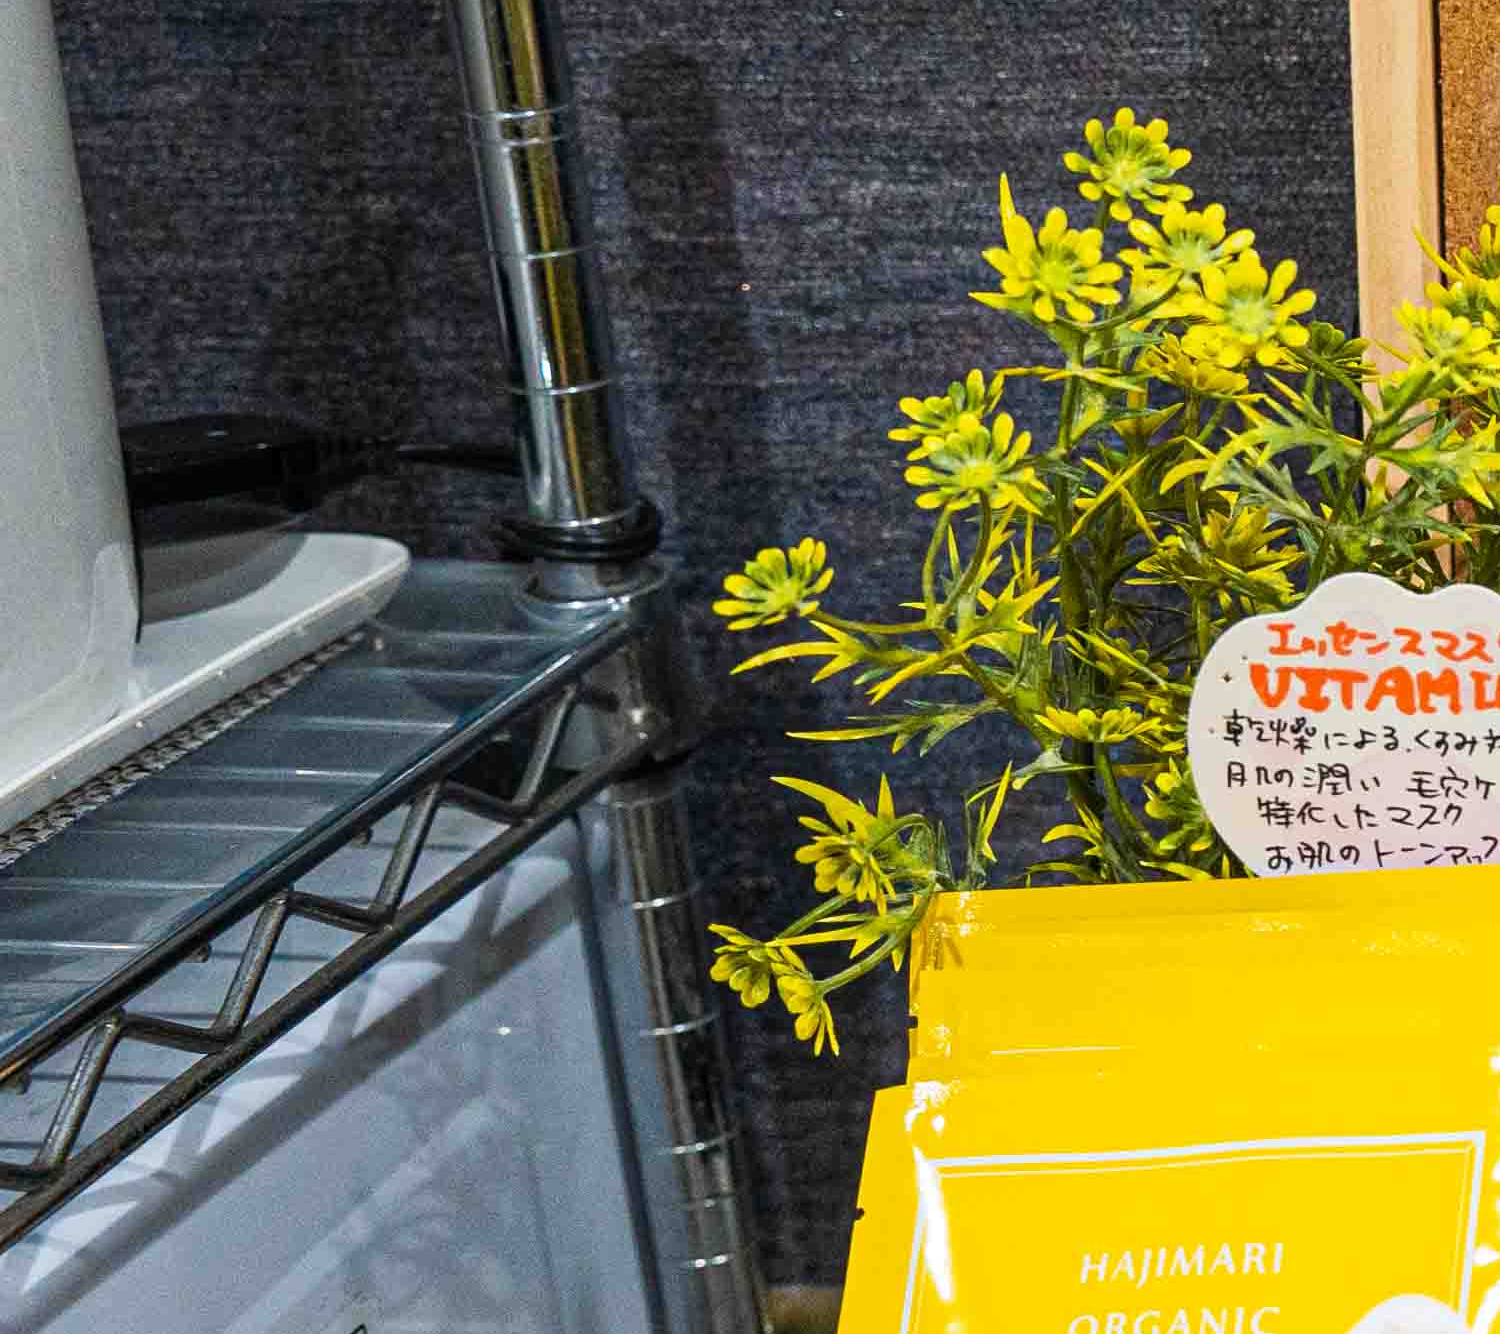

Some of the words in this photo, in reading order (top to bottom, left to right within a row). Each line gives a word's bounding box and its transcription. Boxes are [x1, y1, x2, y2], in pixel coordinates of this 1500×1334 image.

[1258, 796, 1463, 830] 特化したマスク
[1080, 1242, 1284, 1287] HAJIMARI
